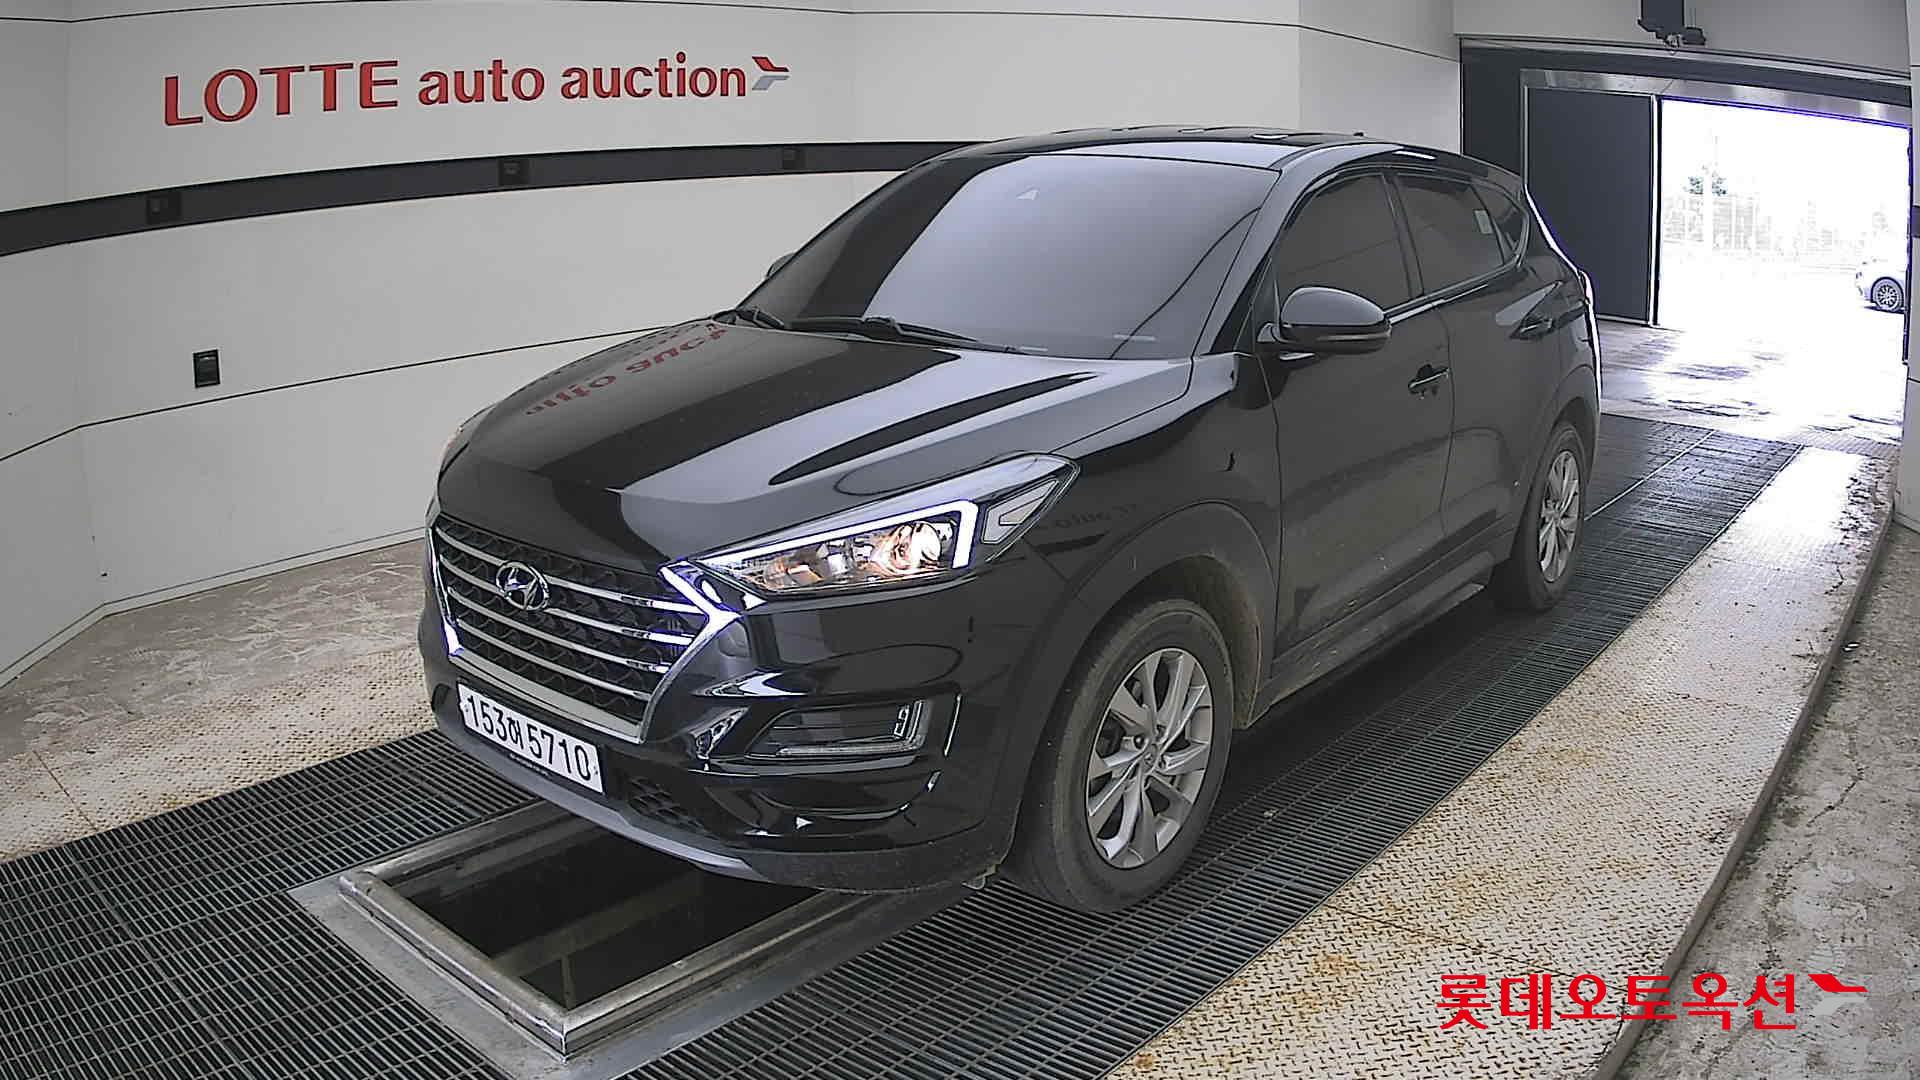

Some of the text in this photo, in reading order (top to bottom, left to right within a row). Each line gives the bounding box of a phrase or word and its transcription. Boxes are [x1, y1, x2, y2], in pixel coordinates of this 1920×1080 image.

[163, 51, 747, 127] LOTTE auto auction
